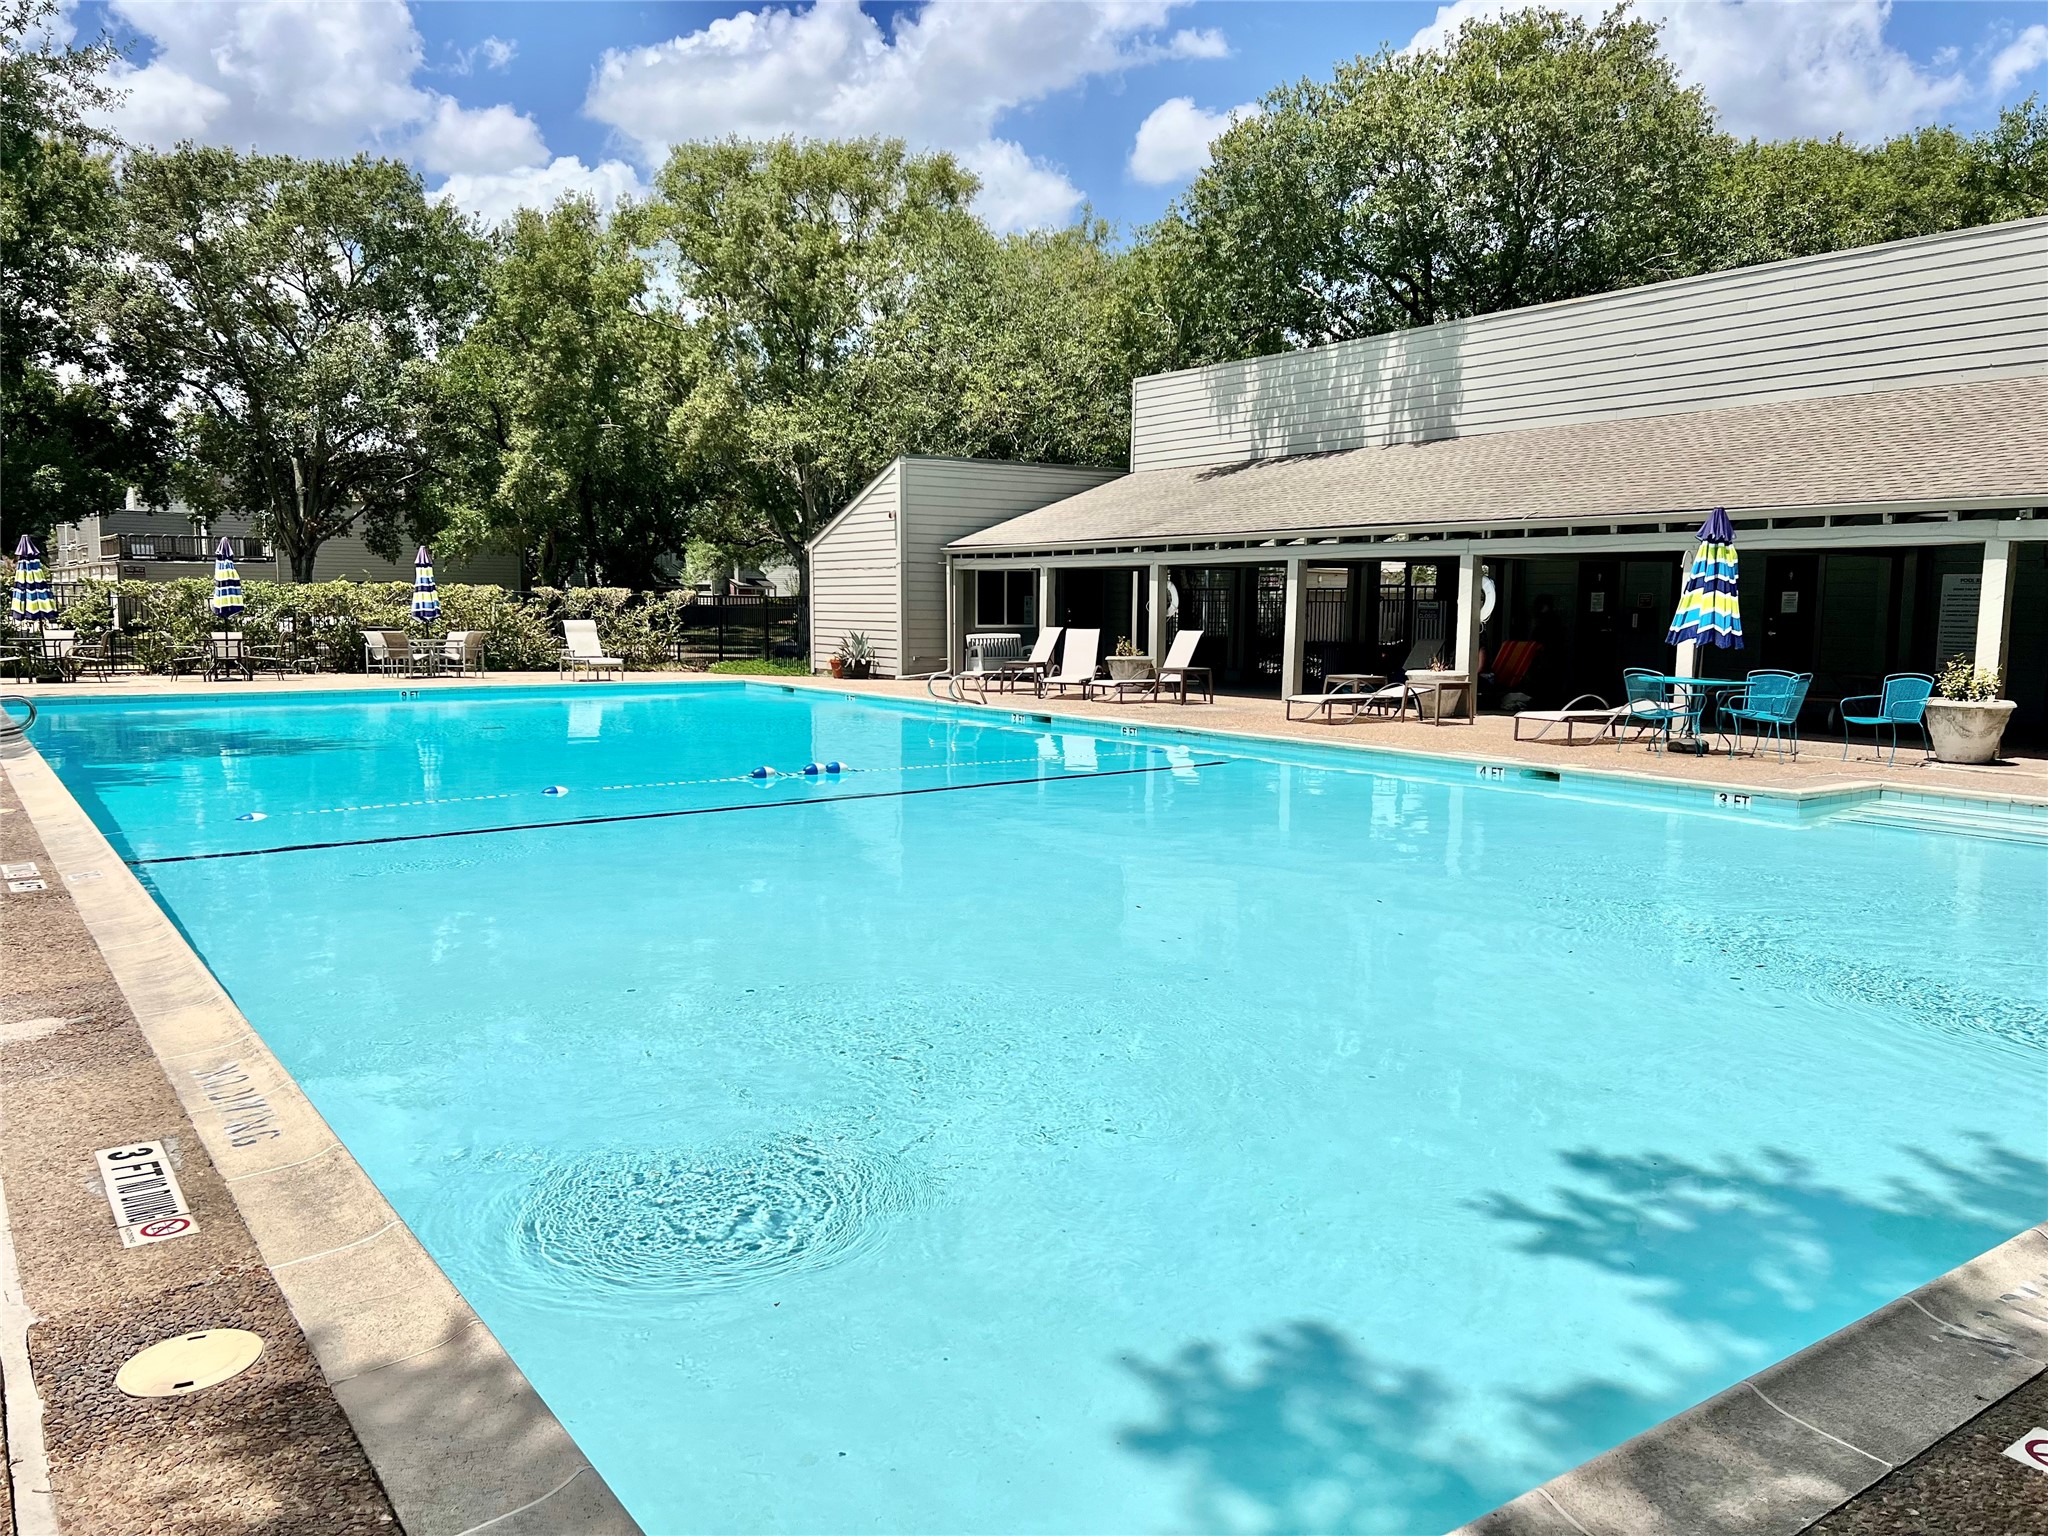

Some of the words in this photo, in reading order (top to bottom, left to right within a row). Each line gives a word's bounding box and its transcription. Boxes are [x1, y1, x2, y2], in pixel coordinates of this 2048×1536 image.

[410, 691, 419, 700] FT
[1491, 767, 1503, 778] FT
[1719, 793, 1728, 805] 3
[1734, 794, 1750, 807] FT
[107, 1147, 154, 1160] 3
[111, 1161, 164, 1180] FT
[116, 1176, 167, 1194] NO
[121, 1189, 179, 1223] DIVING
